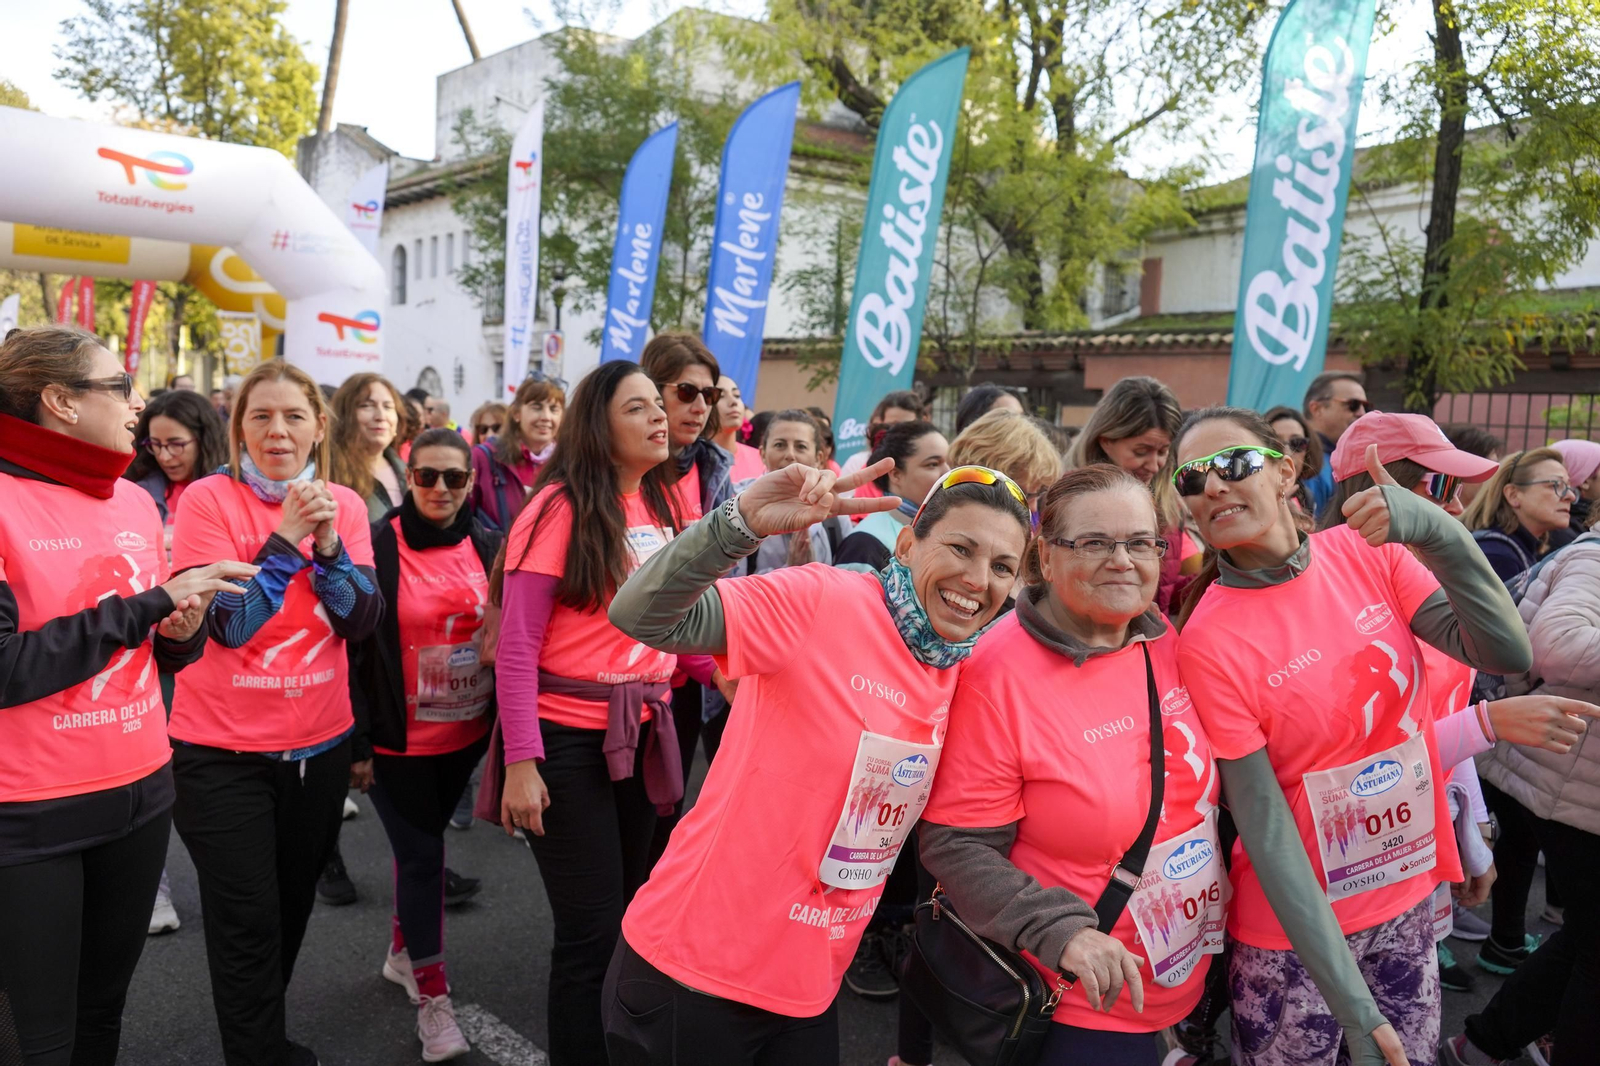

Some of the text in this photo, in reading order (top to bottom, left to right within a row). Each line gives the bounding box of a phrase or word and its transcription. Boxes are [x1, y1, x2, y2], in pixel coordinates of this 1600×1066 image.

[97, 190, 195, 214] TotalEnergies
[1243, 37, 1355, 372] Batiste
[855, 119, 944, 377] Batiste
[712, 192, 771, 339] Marlene
[606, 223, 653, 353] Marlene
[29, 537, 82, 552] OYSHO
[1267, 648, 1322, 688] OYSHO
[232, 674, 281, 689] CARRERA
[284, 676, 298, 689] DE
[299, 674, 312, 687] LA
[284, 688, 304, 698] 2025
[450, 675, 478, 691] 016
[850, 674, 907, 707] OYSHO
[53, 708, 117, 730] CARRERA
[121, 702, 134, 721] DE
[136, 699, 148, 716] LA
[122, 718, 142, 734] 2025
[1083, 715, 1135, 744] OYSHO
[865, 763, 890, 776] SUMA
[1356, 768, 1401, 793] ASTURIANA
[1322, 790, 1349, 805] SUMA
[1365, 801, 1411, 836] 016
[1346, 860, 1373, 875] CARRERA
[1384, 853, 1392, 861] LA
[1392, 845, 1412, 858] MUJER
[1415, 833, 1434, 849] SEVILLA
[1381, 834, 1404, 851] 3420
[850, 851, 869, 861] CARRERA
[870, 851, 876, 861] DE
[877, 851, 883, 861] LA
[1169, 847, 1213, 877] ASTURIANA
[838, 867, 873, 881] OYSHO
[1342, 871, 1386, 892] OYSHO
[1182, 880, 1220, 921] 016
[831, 907, 850, 924] DE
[829, 924, 845, 940] 2025
